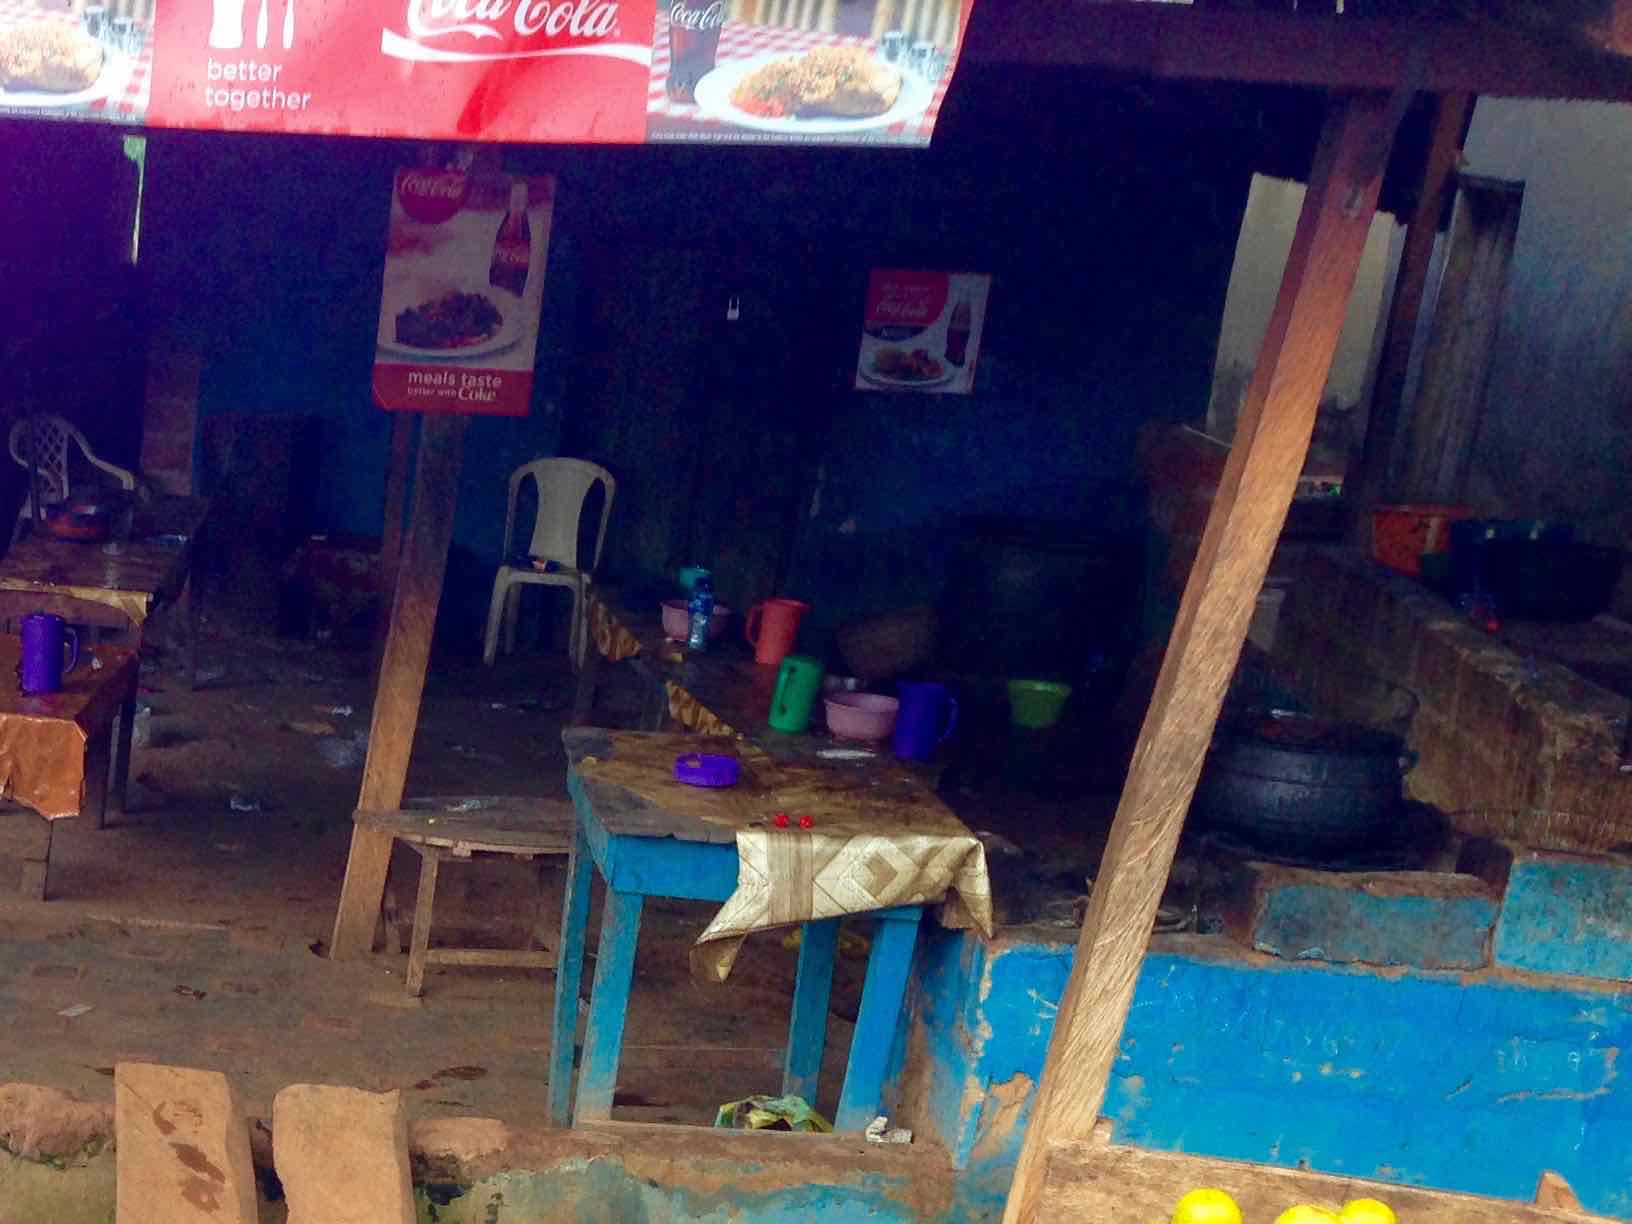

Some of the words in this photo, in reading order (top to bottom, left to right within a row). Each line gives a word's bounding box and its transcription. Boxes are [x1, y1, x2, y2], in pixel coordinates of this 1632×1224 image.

[207, 57, 283, 81] better
[205, 86, 312, 111] together
[408, 371, 456, 385] meals
[461, 373, 503, 389] taste
